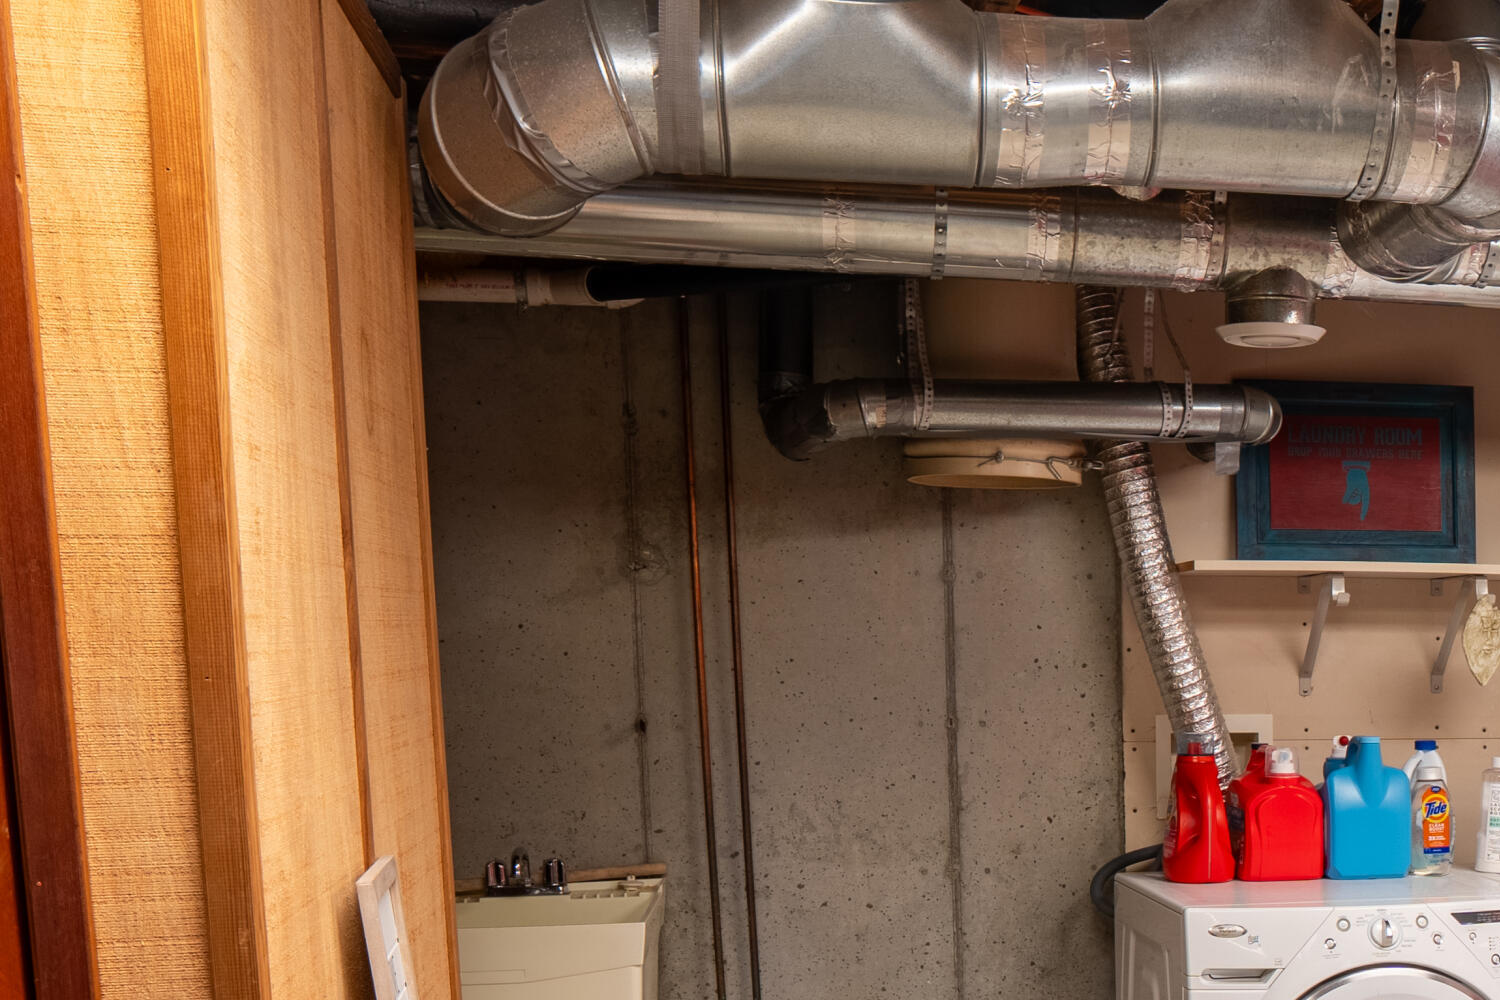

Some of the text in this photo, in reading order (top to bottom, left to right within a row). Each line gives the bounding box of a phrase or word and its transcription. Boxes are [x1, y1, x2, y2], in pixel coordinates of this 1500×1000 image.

[1287, 424, 1423, 446] LAUNDRY ROOM
[1287, 447, 1423, 460] DROP YOUR DRAWERS HERE
[1424, 801, 1448, 819] Tide
